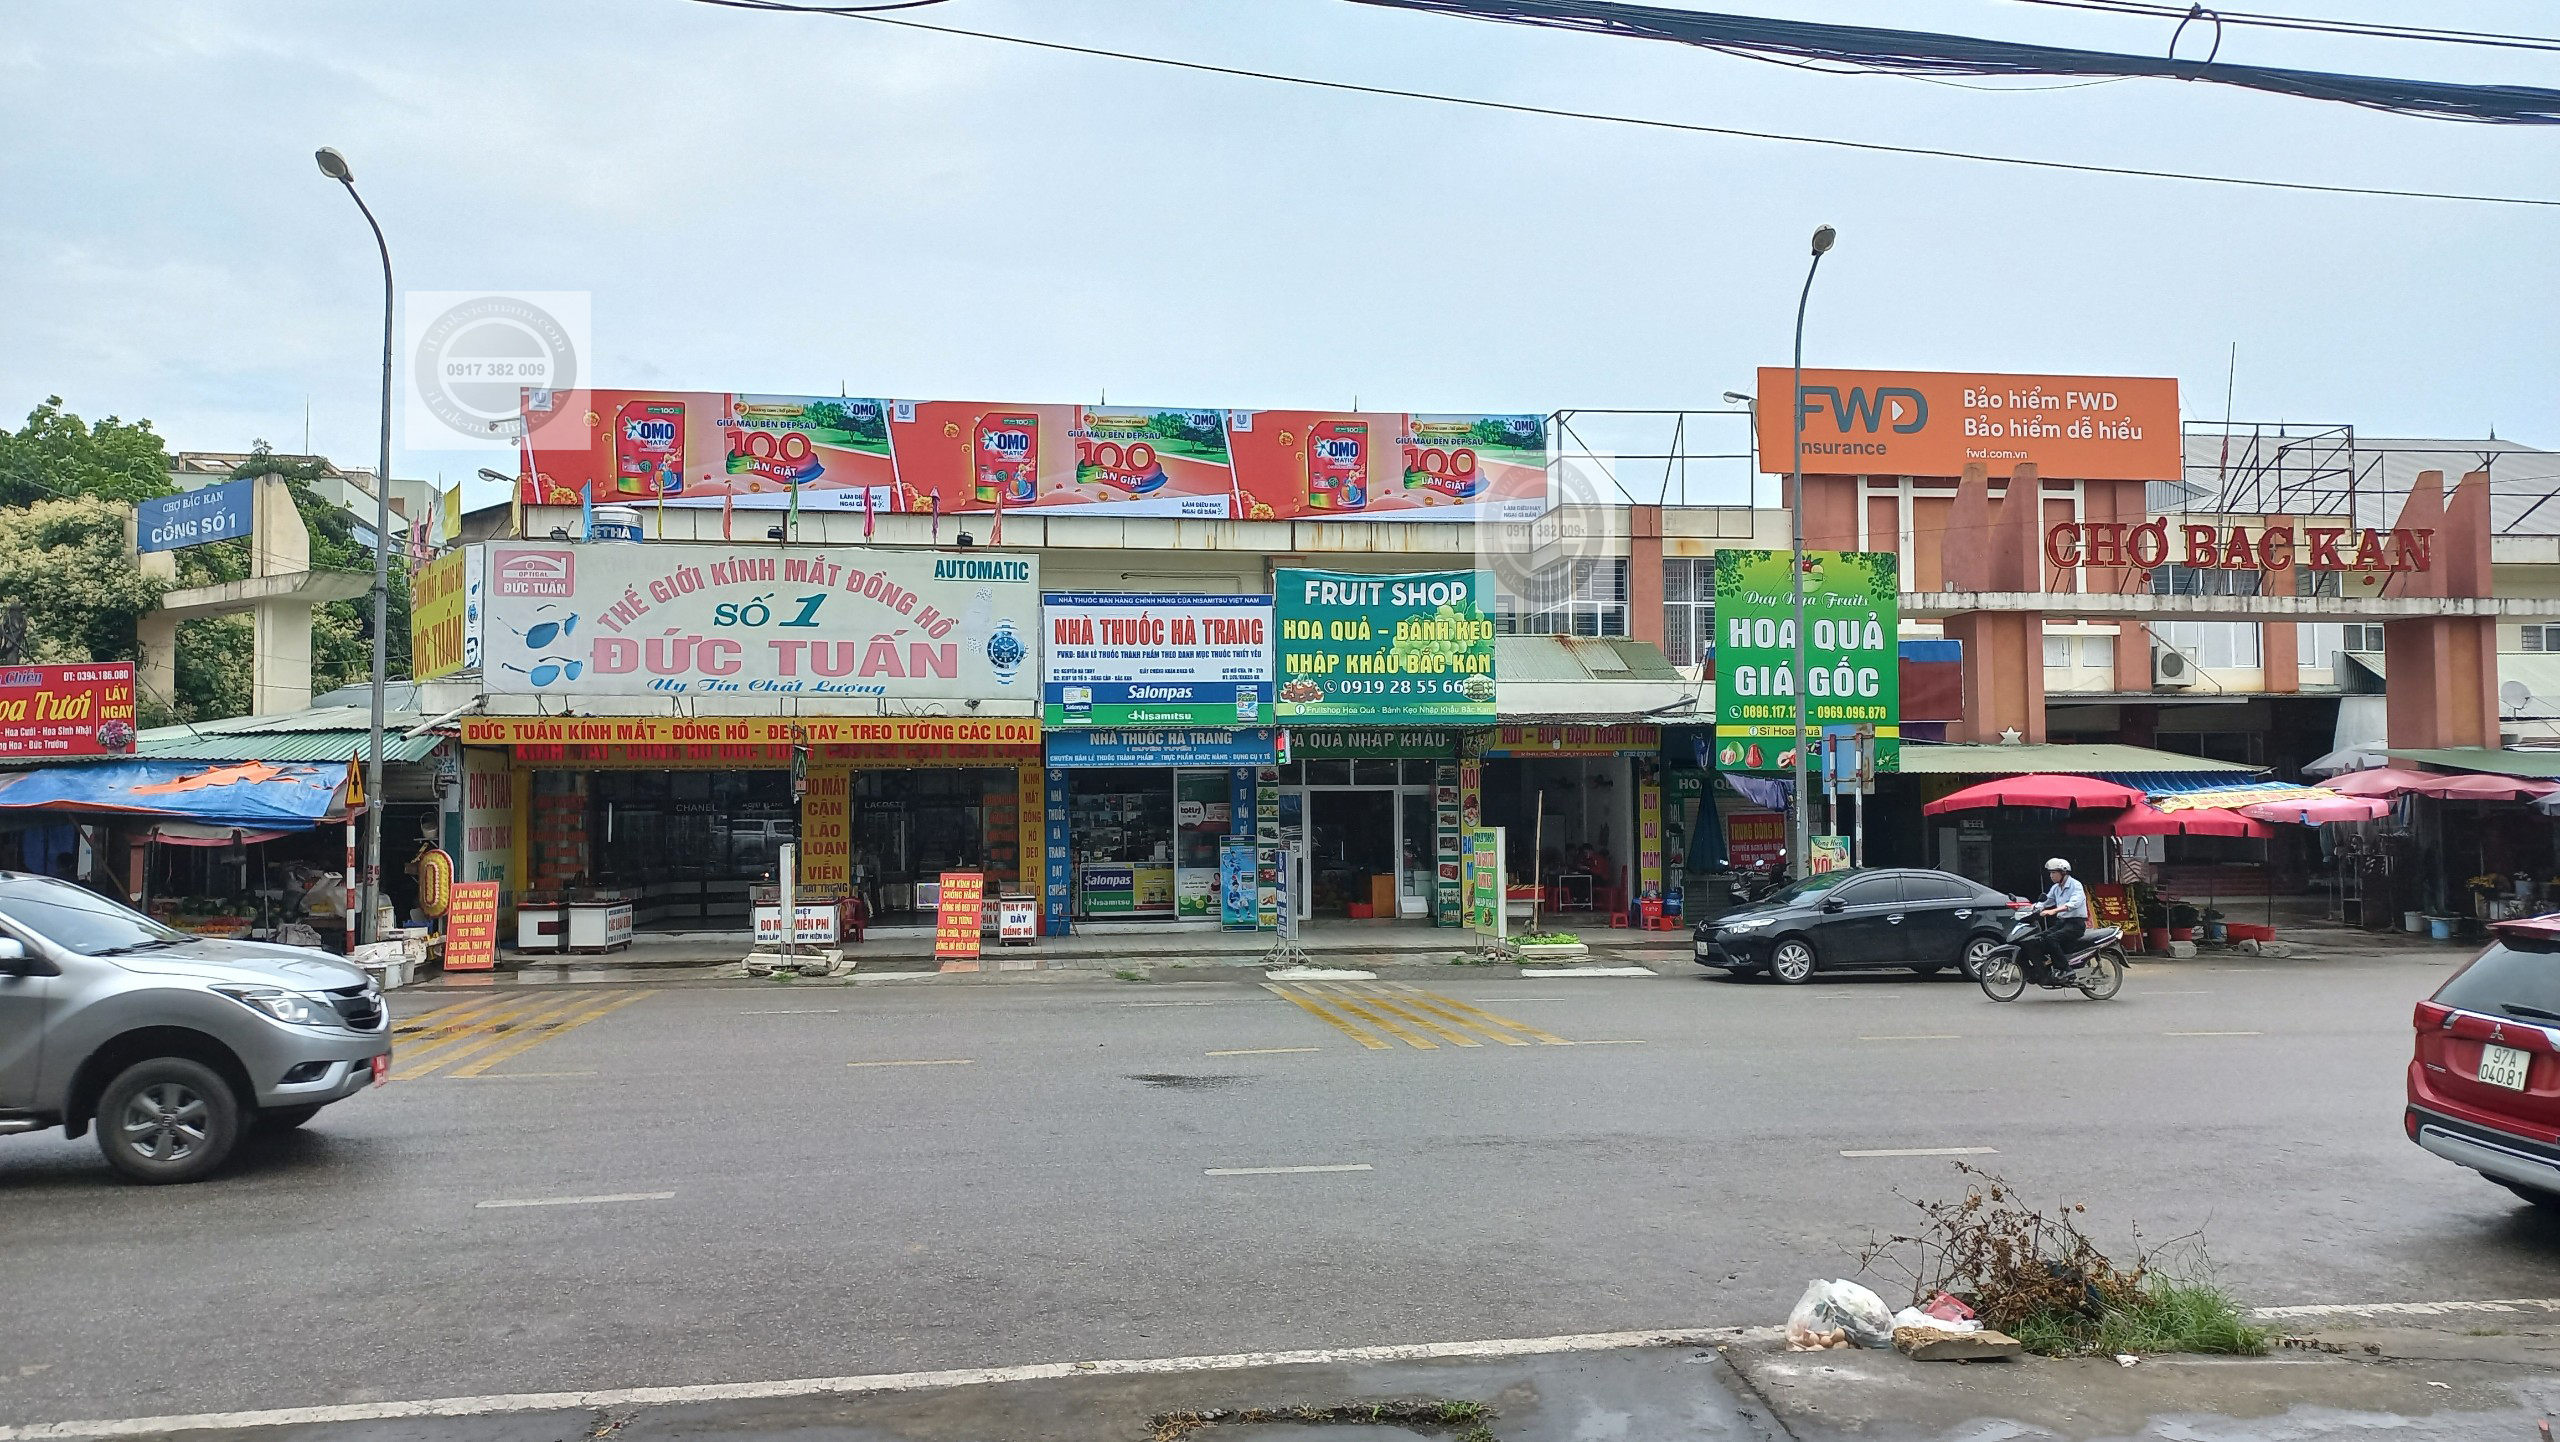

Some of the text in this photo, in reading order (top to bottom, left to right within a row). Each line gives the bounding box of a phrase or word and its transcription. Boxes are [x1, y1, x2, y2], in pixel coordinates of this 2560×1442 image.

[1964, 386, 2118, 411] Bảo hiểm FWD
[852, 404, 876, 416] OMO
[1799, 385, 1928, 434] FWD
[1193, 413, 1216, 427] OMO
[1512, 418, 1535, 432] OMO
[1964, 415, 2142, 440] Bảo hiểm dễ hiểu
[641, 422, 674, 440] OMO
[726, 430, 812, 462] 100
[997, 434, 1029, 450] OMO
[1328, 442, 1358, 458] OMO
[1076, 442, 1156, 471] 100
[1404, 448, 1476, 476] 100
[1966, 448, 2028, 460] fwd.com.vn
[746, 460, 797, 479] LẦN GIẶT
[1095, 468, 1142, 488] LẦN GIẶT
[1420, 474, 1466, 492] LẦN GIẶT
[162, 499, 181, 512] CHỢ
[203, 490, 224, 505] KẠN
[152, 507, 236, 544] CỔNG SỐ 1
[2046, 516, 2169, 584] CHỢ
[2304, 528, 2436, 586] KẠN
[934, 559, 1030, 580] AUTOMATIC
[504, 580, 566, 594] ĐỨC TUẤN
[1304, 580, 1468, 606] FRUIT SHOP
[596, 554, 960, 640] THẾ GIỚI KÍNH MẮT ĐỒNG HỒ
[1741, 590, 1869, 609] Duy Fruits
[713, 592, 828, 627] SỐ 1
[1054, 610, 1264, 646] NHÀ THUỐC HÀ TRANG
[1283, 616, 1493, 645] HOA QUẢ BÁNH KẸO
[1729, 611, 1884, 652] HOA QUẢ
[414, 600, 462, 679] ĐỨC TUẤN
[589, 628, 958, 678] ĐỨC TUẤN
[1099, 649, 1120, 659] THUỐC
[1121, 649, 1141, 658] THÀNH
[1142, 648, 1160, 659] PHẨM
[1162, 650, 1176, 659] THEO
[1177, 650, 1194, 659] DANH
[1195, 650, 1209, 660] MỤC
[1211, 648, 1232, 658] THUỐC
[1233, 648, 1250, 658] THIẾT
[1286, 647, 1491, 678] NHẬP KHẨU BẮC KẠN
[64, 670, 128, 682] ĐT: 0394.186.080
[1735, 656, 1879, 697] GIÁ GỐC
[105, 682, 128, 701] LẤY
[646, 678, 886, 696] Uy Tín Chất Lượng
[1128, 685, 1193, 701] Salonpas
[1340, 680, 1464, 694] 0919 28 55 66
[101, 704, 134, 719] NGAY
[1817, 706, 1886, 719] 0969.096.878
[5, 728, 18, 736] Hoa
[42, 726, 56, 736] Hoa
[58, 726, 74, 736] Sinh
[75, 726, 92, 736] Nhật
[468, 719, 506, 740] ĐỨC
[512, 719, 562, 740] TUẤN
[568, 720, 611, 740] KÍNH
[617, 719, 656, 740] MẮT
[672, 719, 720, 740] ĐỒNG
[726, 719, 749, 740] HỒ
[808, 724, 842, 740] TAY
[851, 724, 892, 740] TREO
[897, 720, 954, 740] TƯỜNG
[958, 721, 991, 740] CÁC
[996, 724, 1034, 743] LOẠI
[1090, 729, 1233, 745] NHÀ THUỐC HÀ TRANG
[1051, 788, 1062, 802] NHÀ
[676, 803, 718, 812] CHANEL
[808, 800, 842, 818] CẬN
[1048, 806, 1065, 821] THUỐC
[809, 821, 841, 837] LÃO
[1053, 825, 1060, 840] HÀ
[804, 841, 847, 858] LOẠN
[1048, 846, 1066, 858] TRANG
[808, 860, 843, 880] VIỄN
[1026, 866, 1039, 878] TAY
[1051, 865, 1062, 879] ĐẠT
[942, 879, 955, 888] LÀM
[1084, 874, 1132, 888] Salonpas
[943, 889, 962, 899] CHỐNG
[1002, 904, 1020, 912] THAY
[1051, 902, 1063, 915] GPP
[1002, 926, 1033, 936] ĐỒNG HỒ
[2493, 1047, 2517, 1068] 97A
[2480, 1062, 2523, 1088] 040.81
